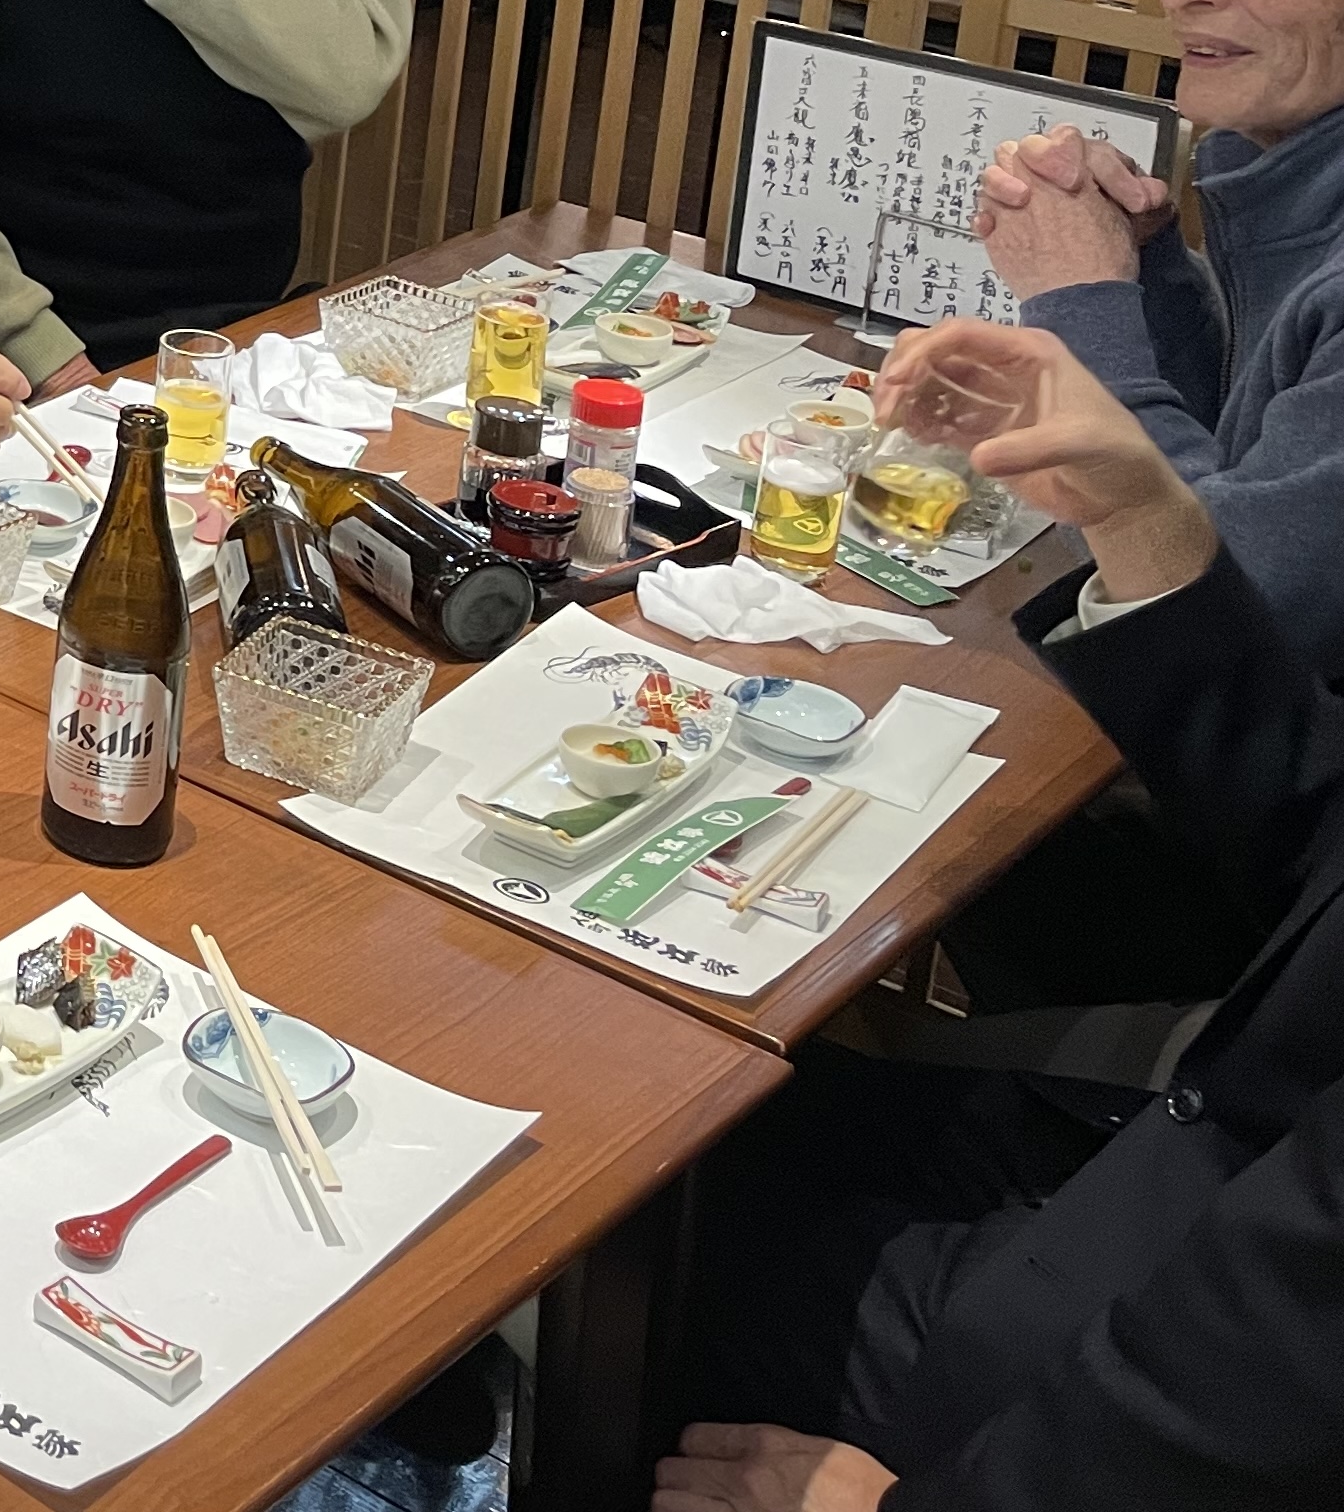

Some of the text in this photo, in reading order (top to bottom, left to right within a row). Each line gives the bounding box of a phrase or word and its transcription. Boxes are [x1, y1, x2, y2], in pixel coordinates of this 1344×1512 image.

[57, 709, 154, 759] Asahi
[86, 760, 110, 780] 生
[617, 926, 740, 978] 近江家
